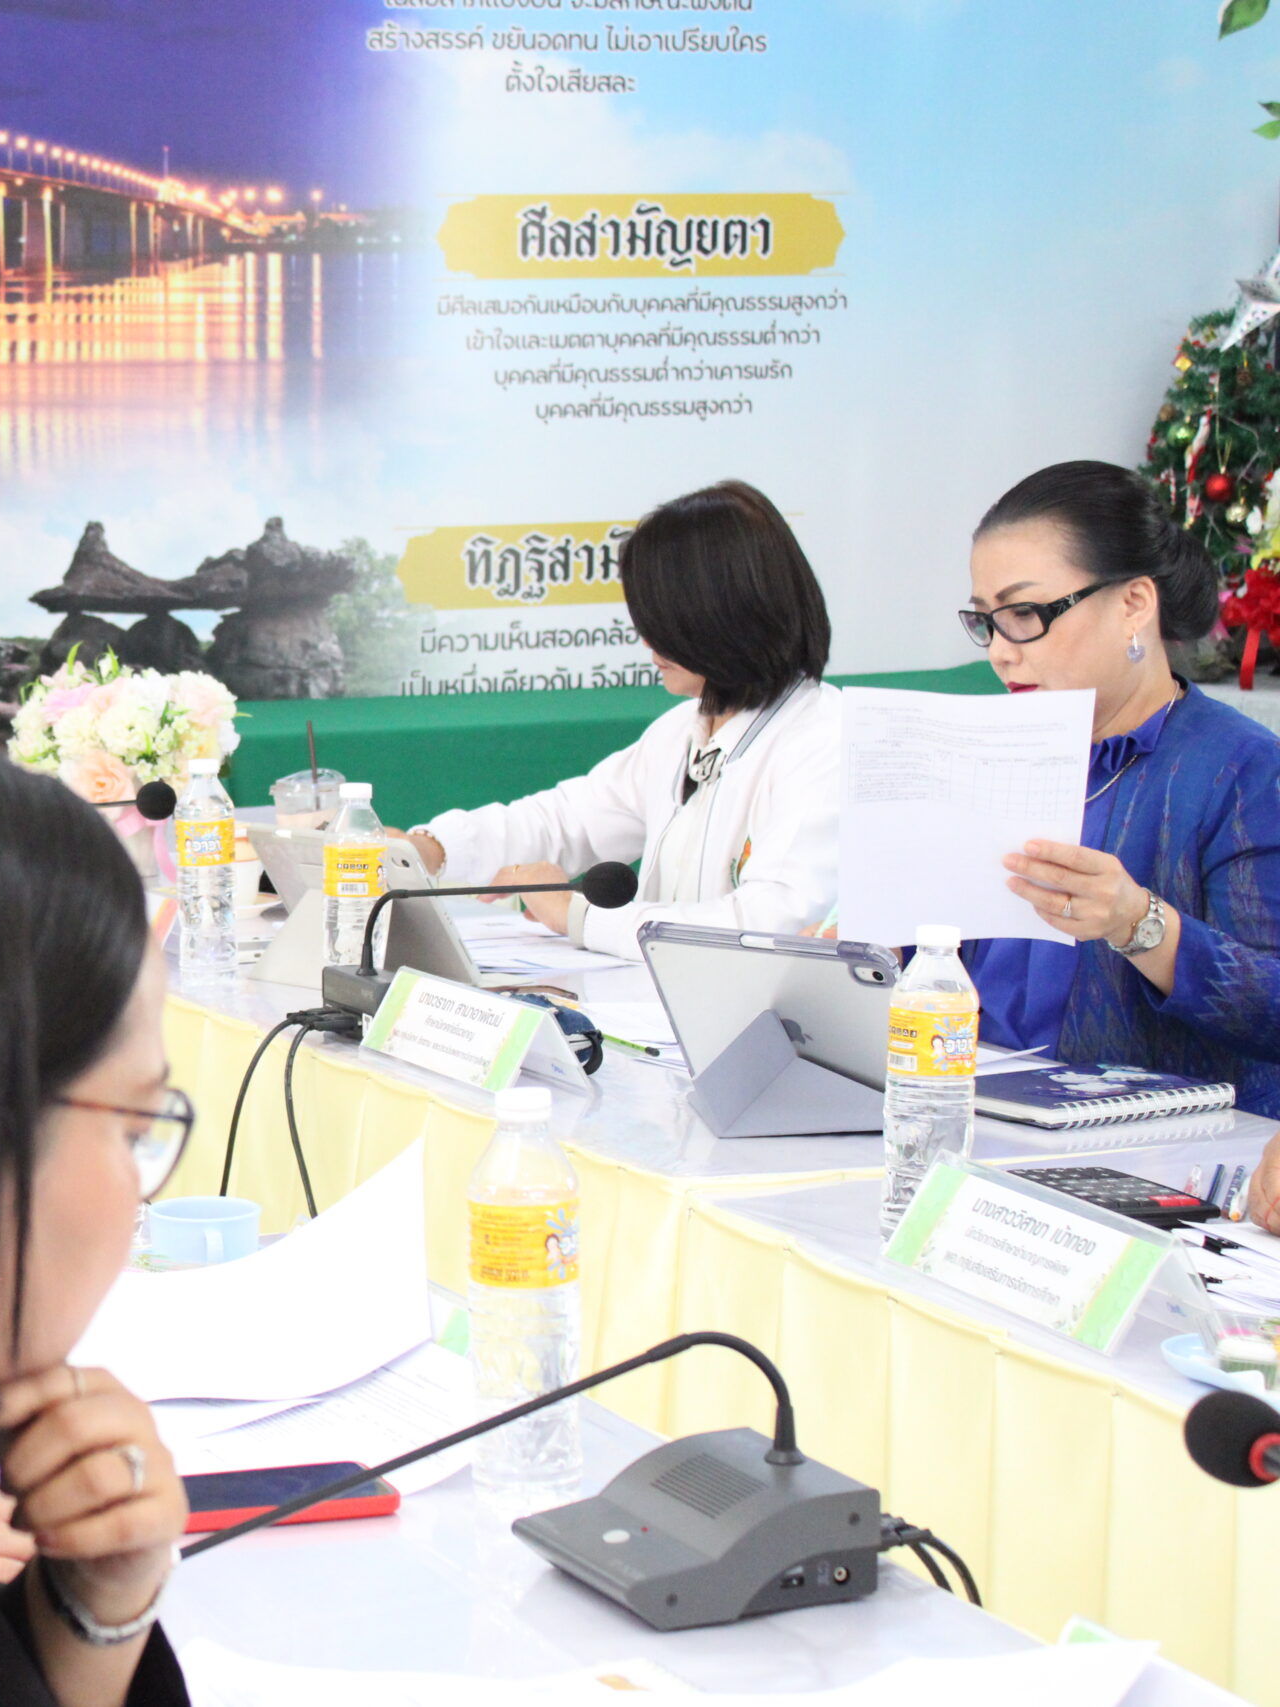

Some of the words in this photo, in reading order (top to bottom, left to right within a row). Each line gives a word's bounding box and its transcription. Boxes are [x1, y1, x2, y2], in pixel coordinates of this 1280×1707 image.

[367, 23, 484, 51] สร้างสรรค์
[492, 27, 598, 51] ขยันอดทน
[606, 25, 767, 52] ไม่เอาเปรียบใคร
[505, 63, 635, 93] ตั้งใจเสียสละ
[467, 528, 635, 598] ทิฏฐิสามั
[420, 619, 641, 653] มีความเห็นสอดคล้อ
